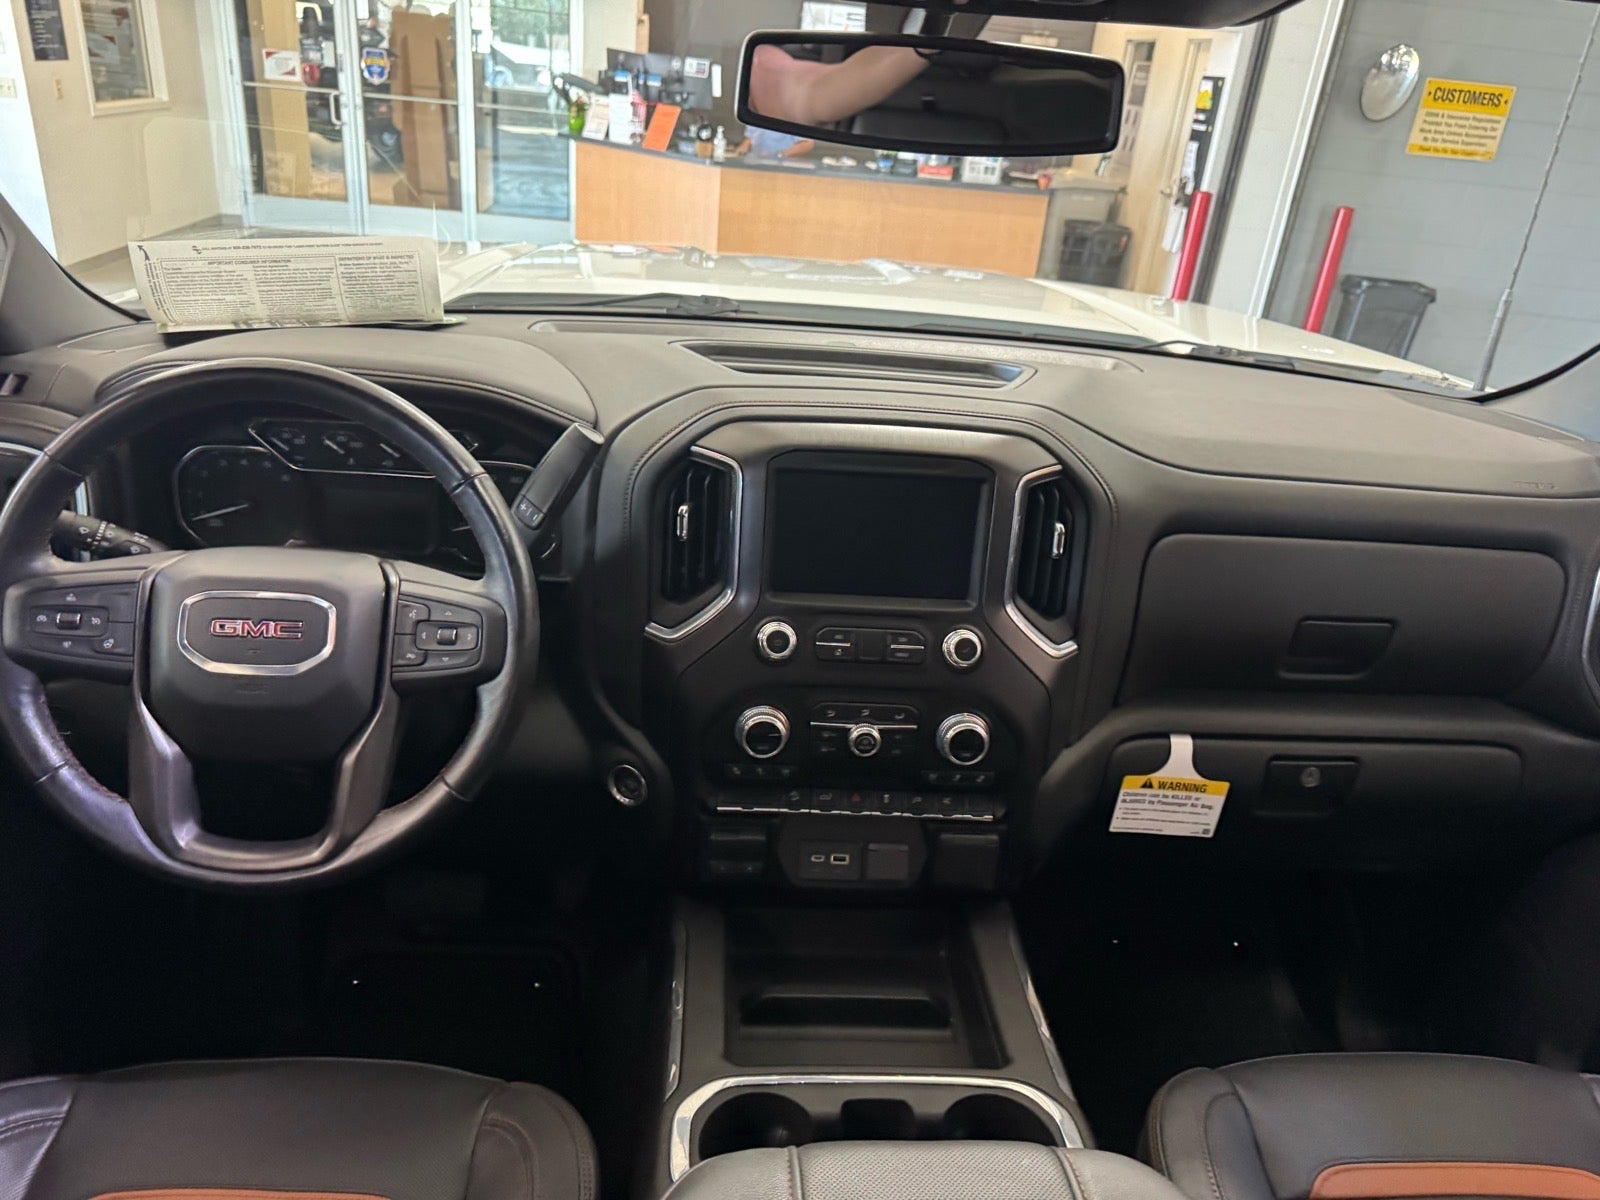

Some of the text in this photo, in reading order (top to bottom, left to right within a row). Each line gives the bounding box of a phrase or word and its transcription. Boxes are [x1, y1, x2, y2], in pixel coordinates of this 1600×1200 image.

[1433, 87, 1503, 107] CUSTOMERS
[210, 618, 303, 638] GMC
[1158, 781, 1208, 793] WARNING
